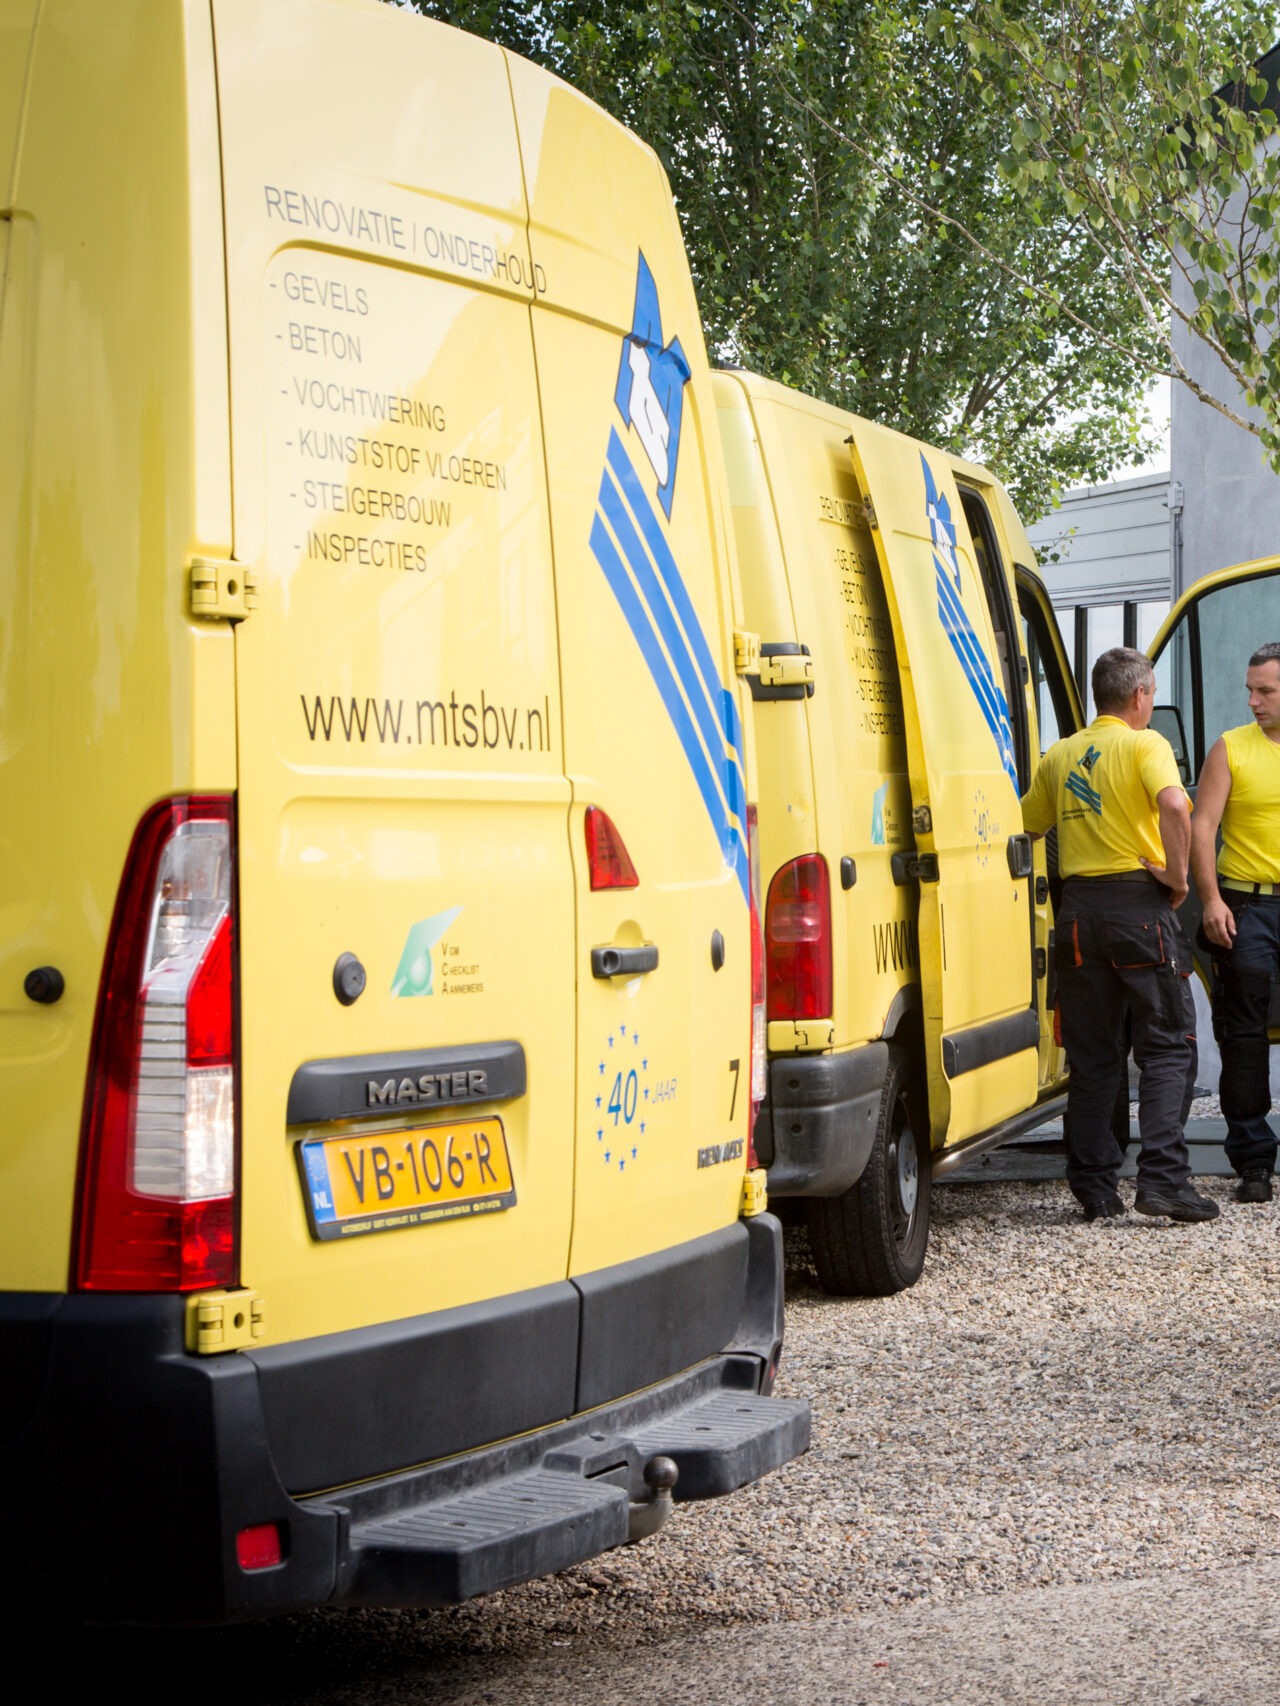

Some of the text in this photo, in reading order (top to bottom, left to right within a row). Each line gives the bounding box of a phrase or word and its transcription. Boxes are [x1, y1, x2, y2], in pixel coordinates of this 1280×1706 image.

[264, 186, 406, 250] RENOVATIE
[424, 226, 547, 293] ONDERHOUD
[284, 272, 369, 316] GEVELS
[289, 322, 362, 363] BETON
[293, 376, 446, 432] VOCHTWERING
[299, 428, 507, 490] KUNSTSTOF VLOEREN
[303, 480, 451, 527] STEIGERBOUW
[307, 531, 427, 573] INSPECTIES
[300, 689, 551, 752] www.mtsbv.nl
[367, 1070, 488, 1107] MASTER
[607, 1069, 638, 1126] 40
[728, 1058, 740, 1121] 7
[343, 1132, 497, 1204] VB-106-R
[313, 1191, 332, 1210] NL
